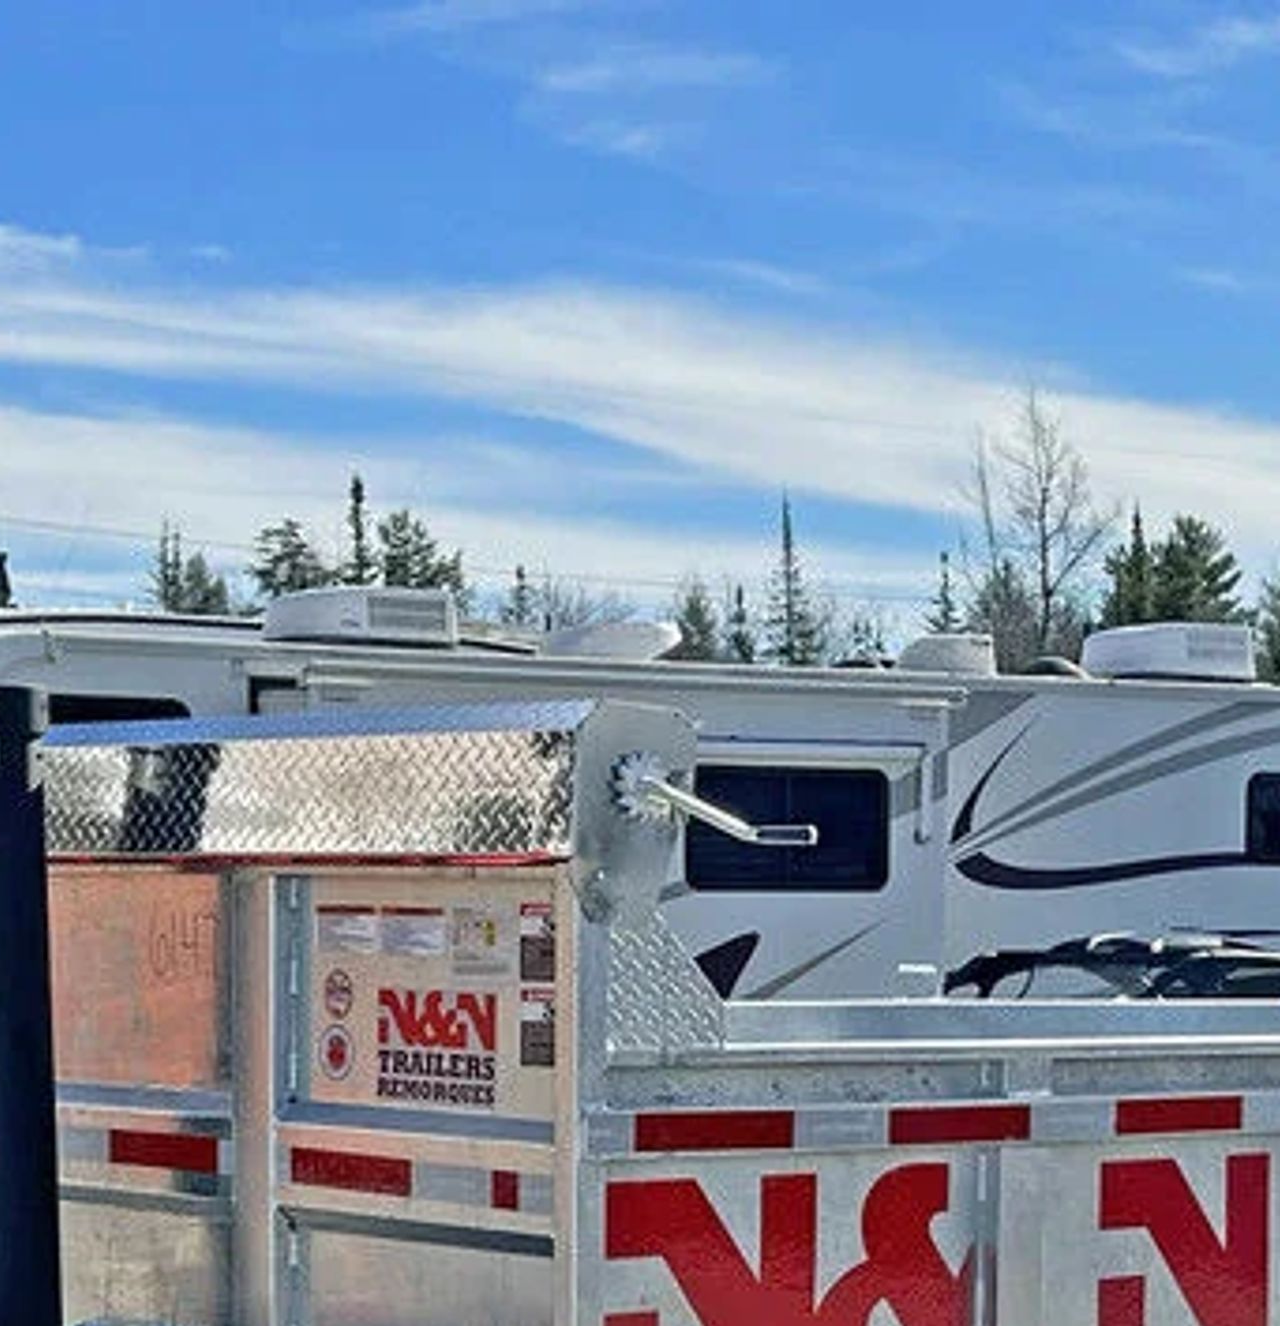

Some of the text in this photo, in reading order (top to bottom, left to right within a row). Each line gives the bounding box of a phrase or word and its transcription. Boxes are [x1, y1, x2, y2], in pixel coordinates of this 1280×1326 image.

[377, 989, 496, 1051] N&N
[377, 1050, 496, 1081] TRAILERS
[377, 1077, 496, 1105] REMORQUES
